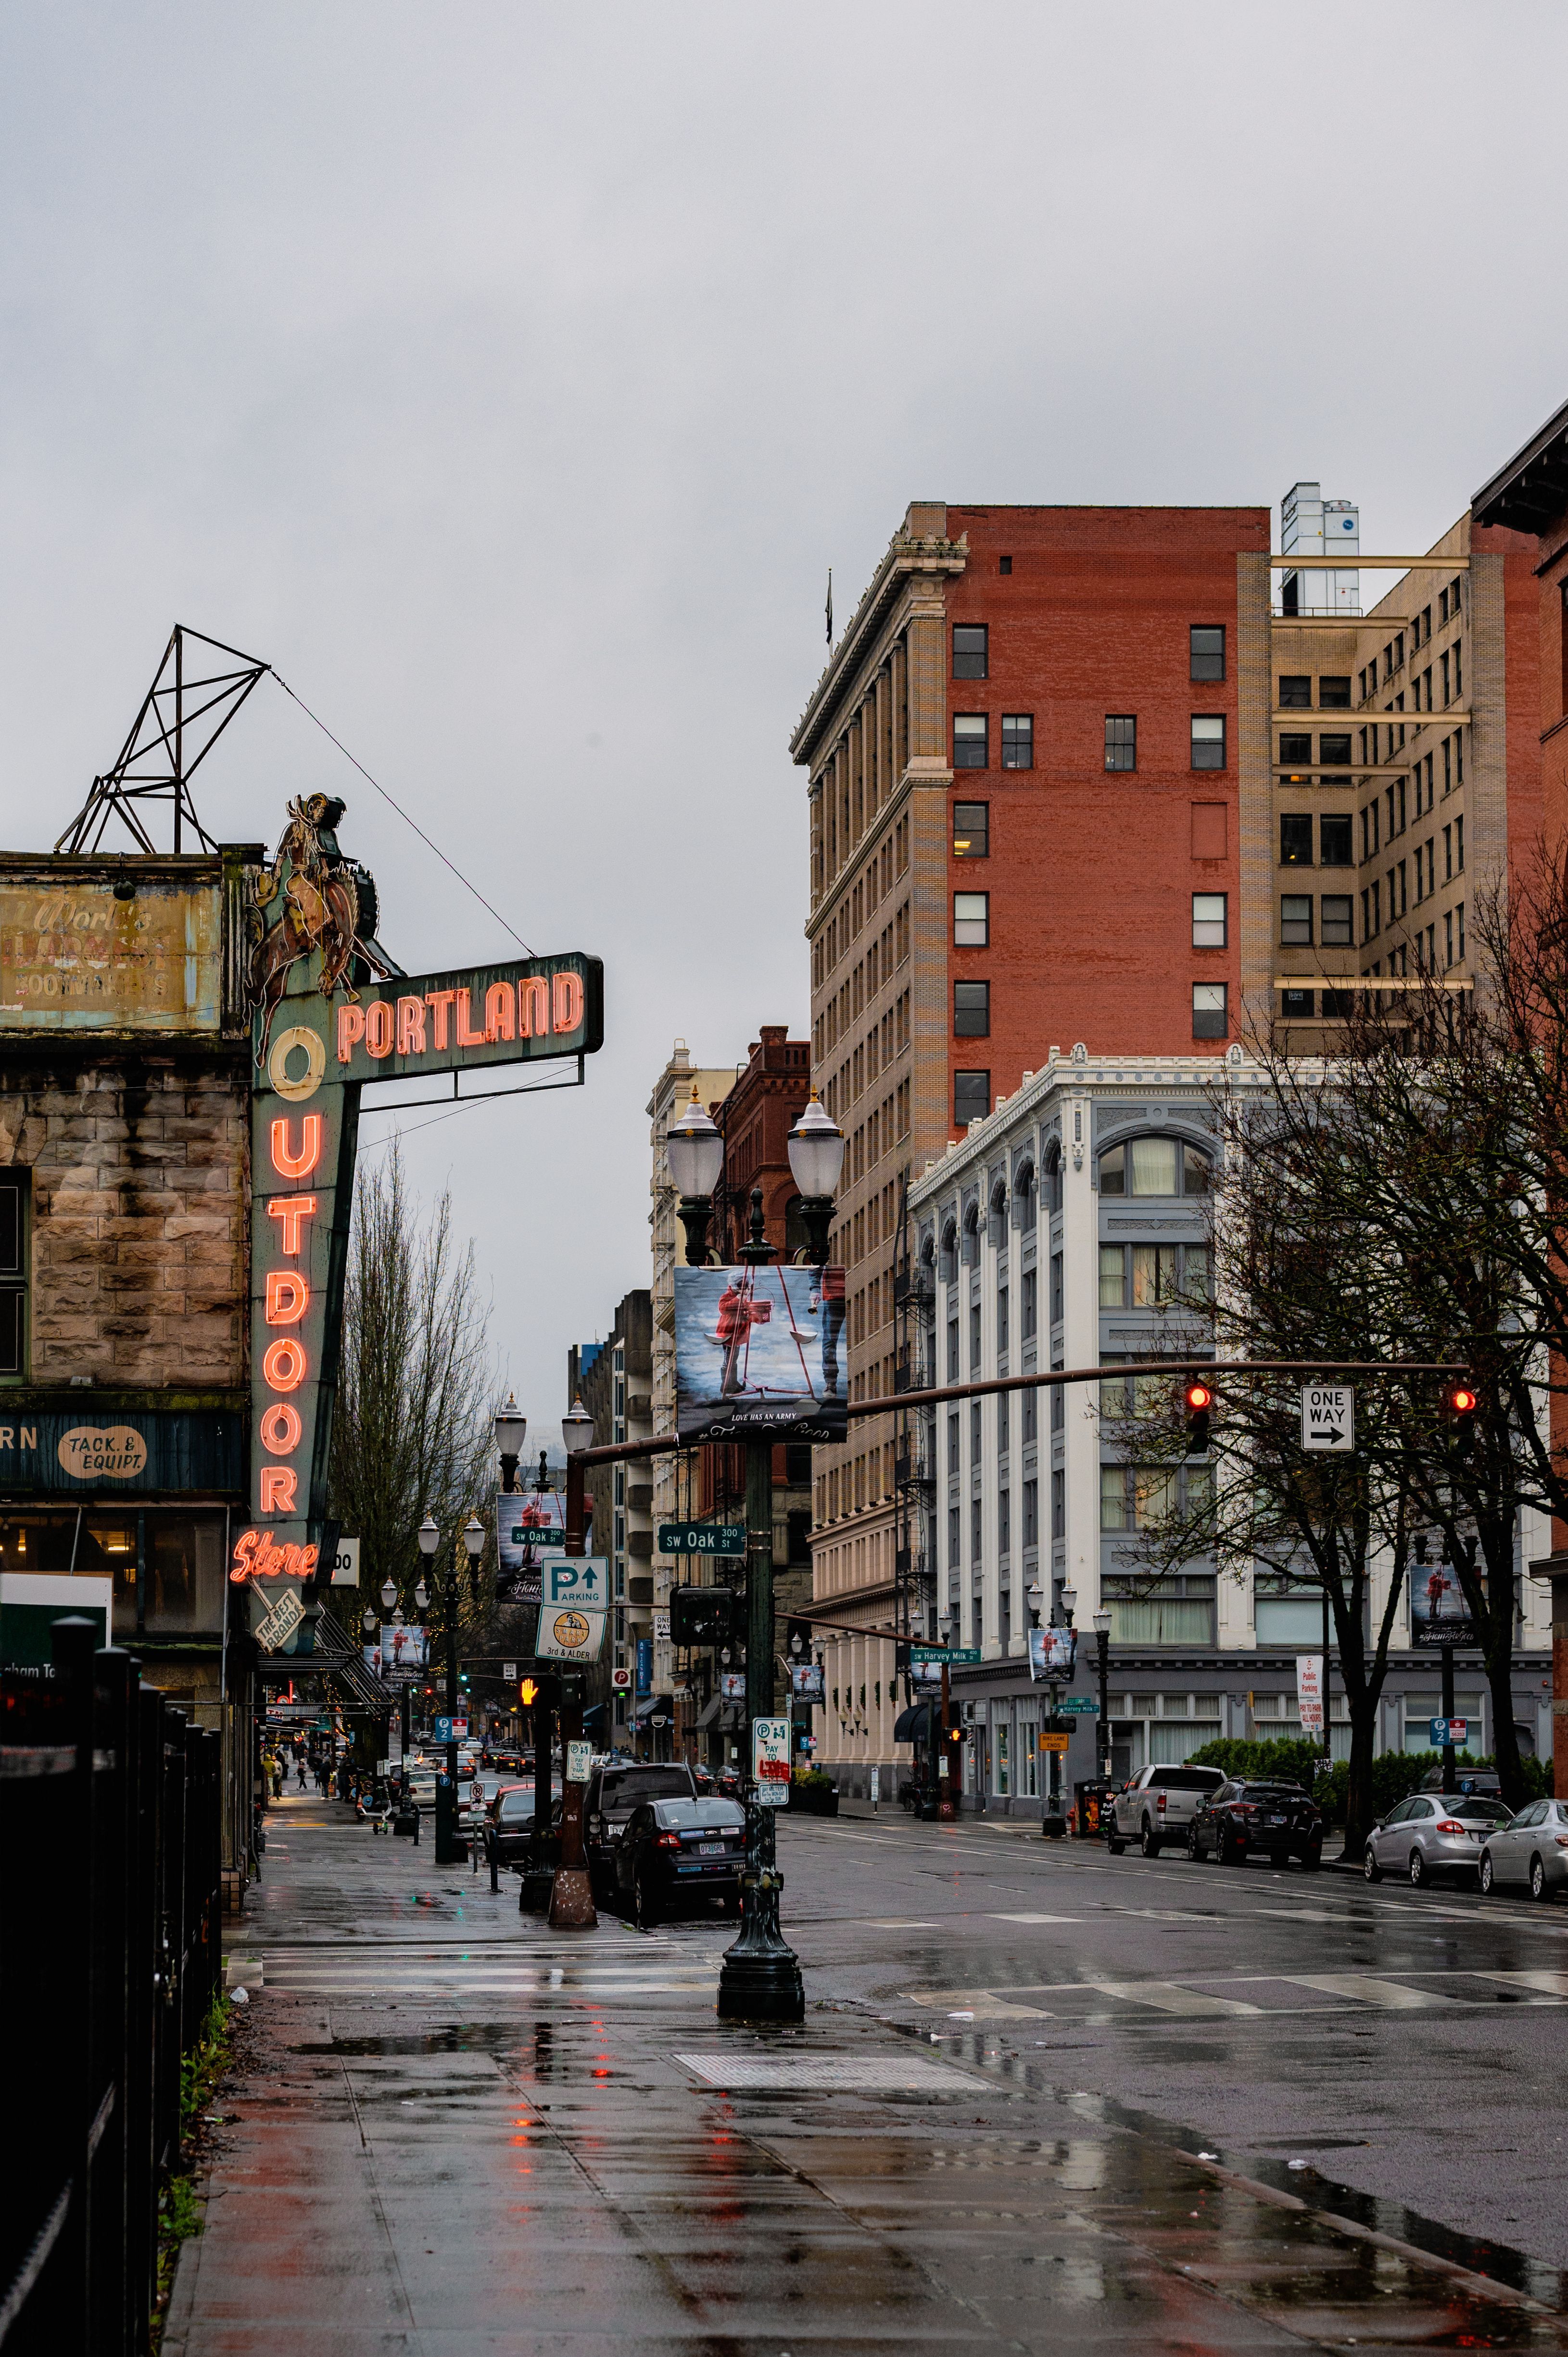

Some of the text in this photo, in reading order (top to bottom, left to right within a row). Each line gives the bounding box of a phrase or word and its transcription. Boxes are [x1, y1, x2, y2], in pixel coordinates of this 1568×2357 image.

[338, 971, 584, 1064] PORTLAND
[260, 1026, 326, 1512] OUTDOOR
[1311, 1392, 1344, 1405] ONE
[1310, 1409, 1345, 1423] WAY
[125, 1437, 135, 1451] &
[530, 1531, 546, 1542] Oak
[722, 1529, 738, 1537] 300
[667, 1531, 730, 1548] SW Oak St
[230, 1530, 318, 1582] Store
[506, 1580, 542, 1594] #FIGHT
[258, 1594, 294, 1639] THE BEST
[556, 1628, 586, 1636] SMART
[559, 1635, 582, 1644] PARK
[547, 1647, 558, 1655] 3rd
[568, 1649, 590, 1659] ALDER
[924, 1652, 949, 1661] Harvey
[1303, 1672, 1316, 1680] Public
[1302, 1684, 1317, 1694] Parking
[1312, 1704, 1322, 1712] PARK
[1309, 1714, 1322, 1722] HOURS
